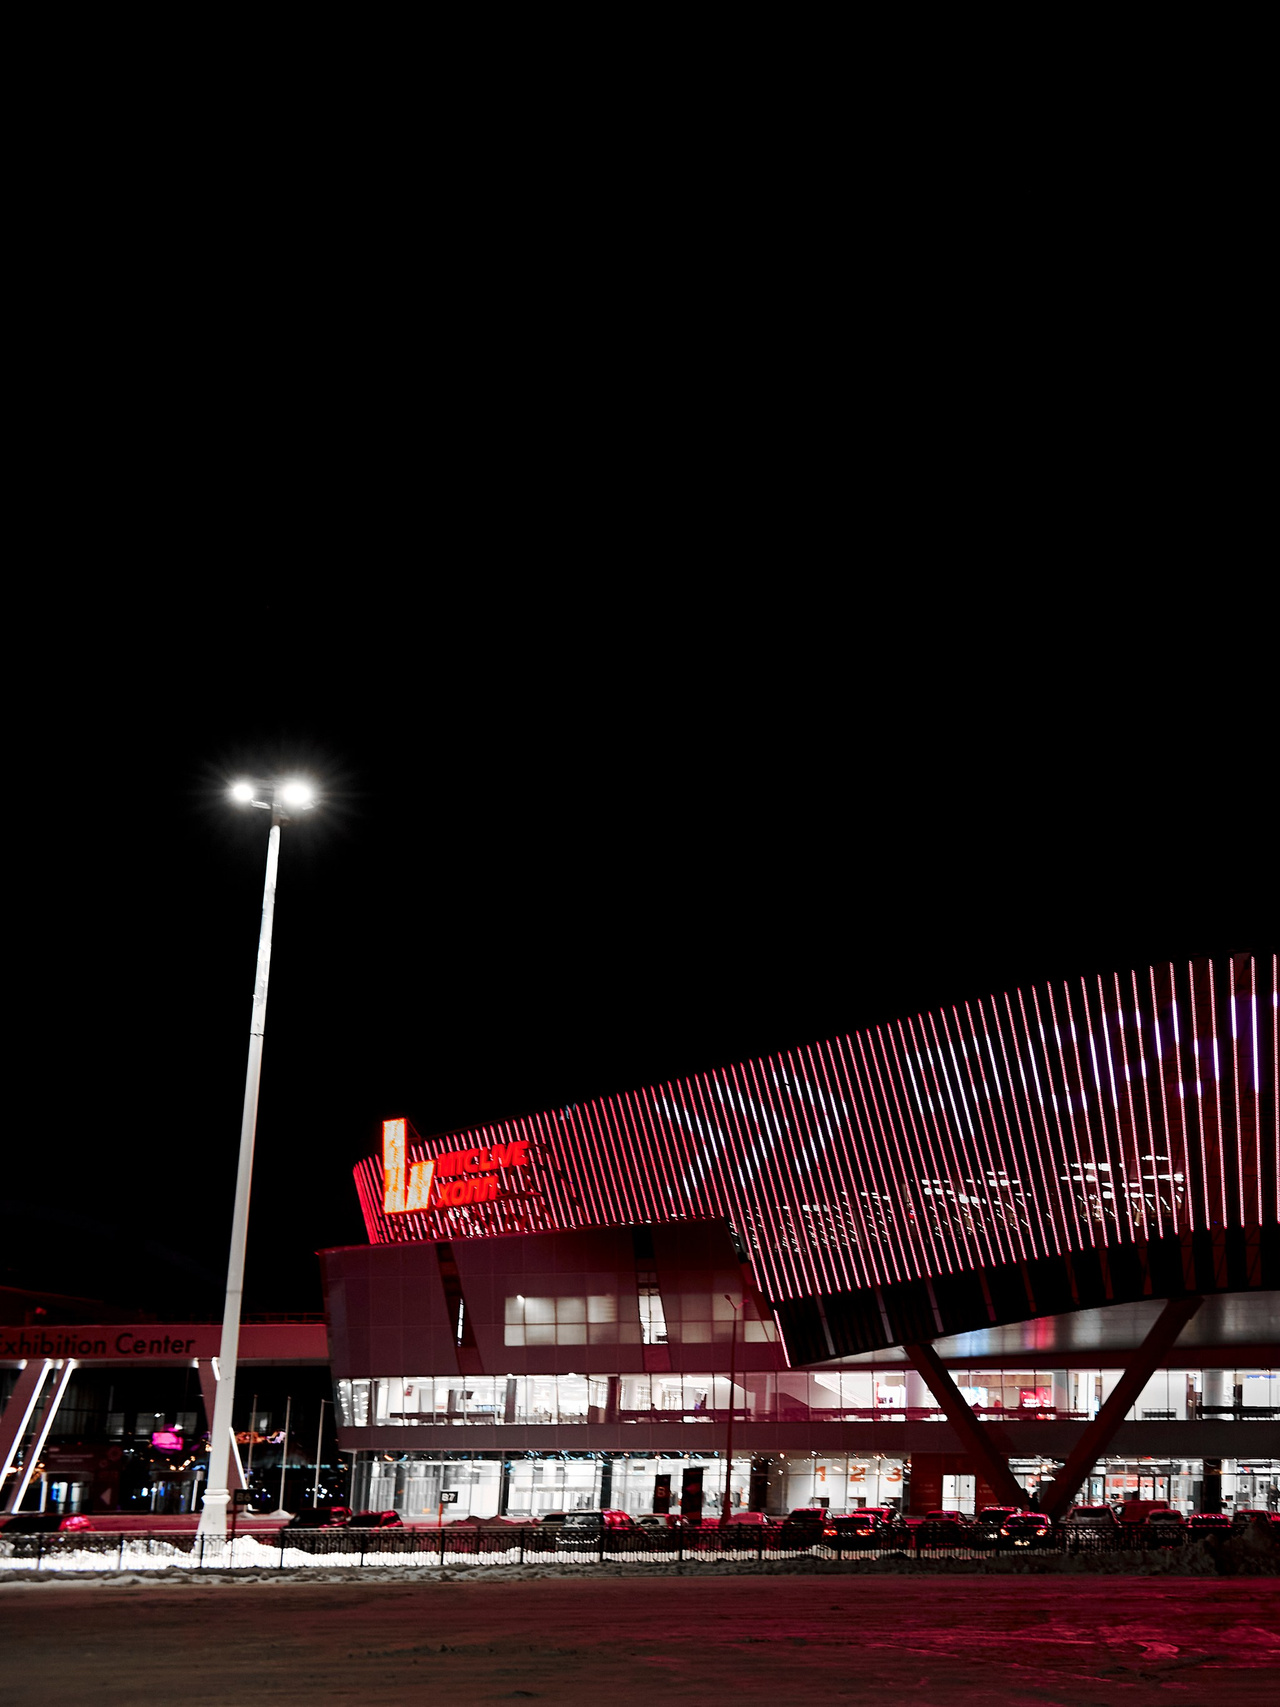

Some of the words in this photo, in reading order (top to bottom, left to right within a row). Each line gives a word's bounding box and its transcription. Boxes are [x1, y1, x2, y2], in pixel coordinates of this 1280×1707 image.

[0, 1333, 107, 1355] xhibition
[115, 1333, 195, 1354] Center
[815, 1466, 826, 1481] 1
[850, 1466, 866, 1482] 2
[886, 1466, 902, 1482] 3
